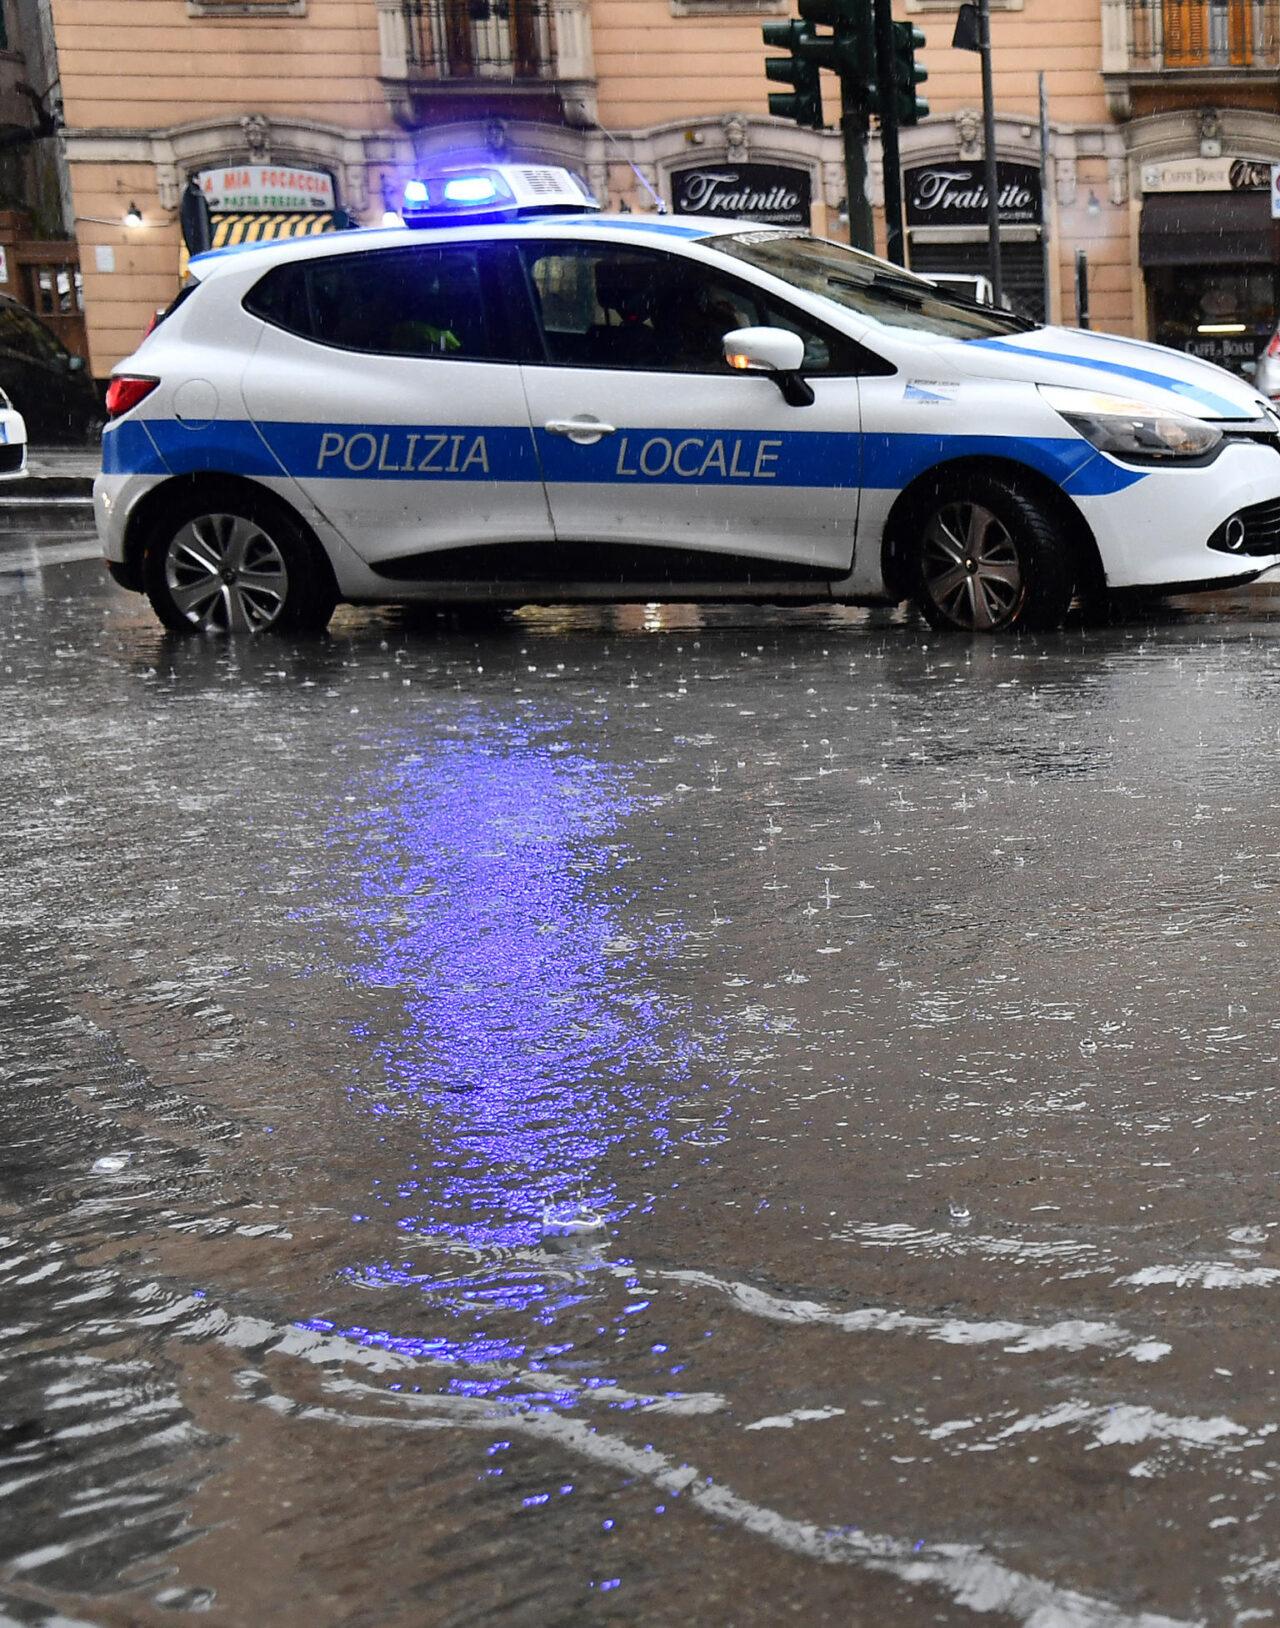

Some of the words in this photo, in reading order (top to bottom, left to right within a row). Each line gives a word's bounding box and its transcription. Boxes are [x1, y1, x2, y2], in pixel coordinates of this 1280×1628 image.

[224, 172, 251, 190] MIA
[261, 171, 329, 193] FOCACCIA
[680, 172, 800, 212] Trainito
[223, 195, 260, 207] PASTA
[316, 432, 490, 474] POLIZIA
[615, 437, 783, 478] LOCALE
